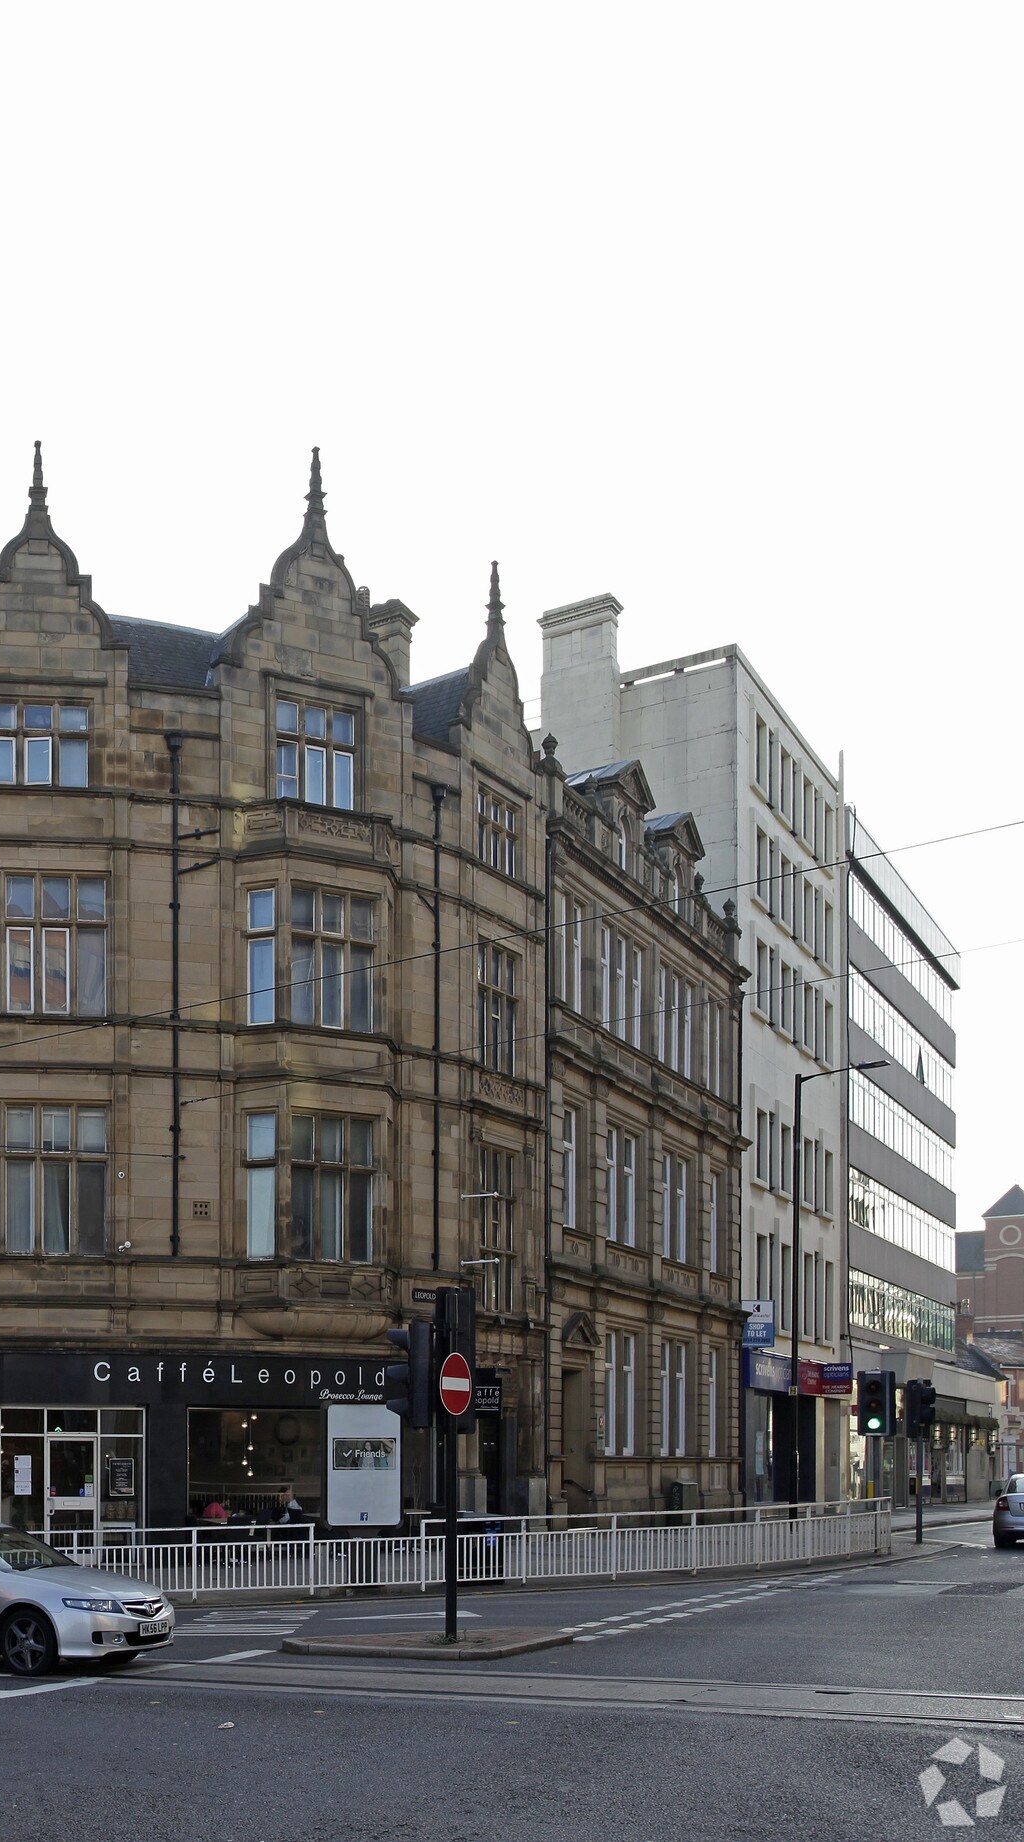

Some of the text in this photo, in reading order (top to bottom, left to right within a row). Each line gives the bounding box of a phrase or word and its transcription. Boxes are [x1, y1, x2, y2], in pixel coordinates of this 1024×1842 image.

[415, 1291, 436, 1300] LEOPOLD
[93, 1360, 385, 1389] Caffé Leopold
[319, 1388, 384, 1401] Prosecco Lounge
[355, 1449, 386, 1458] Friends
[141, 1621, 168, 1635] HK56 LPP
